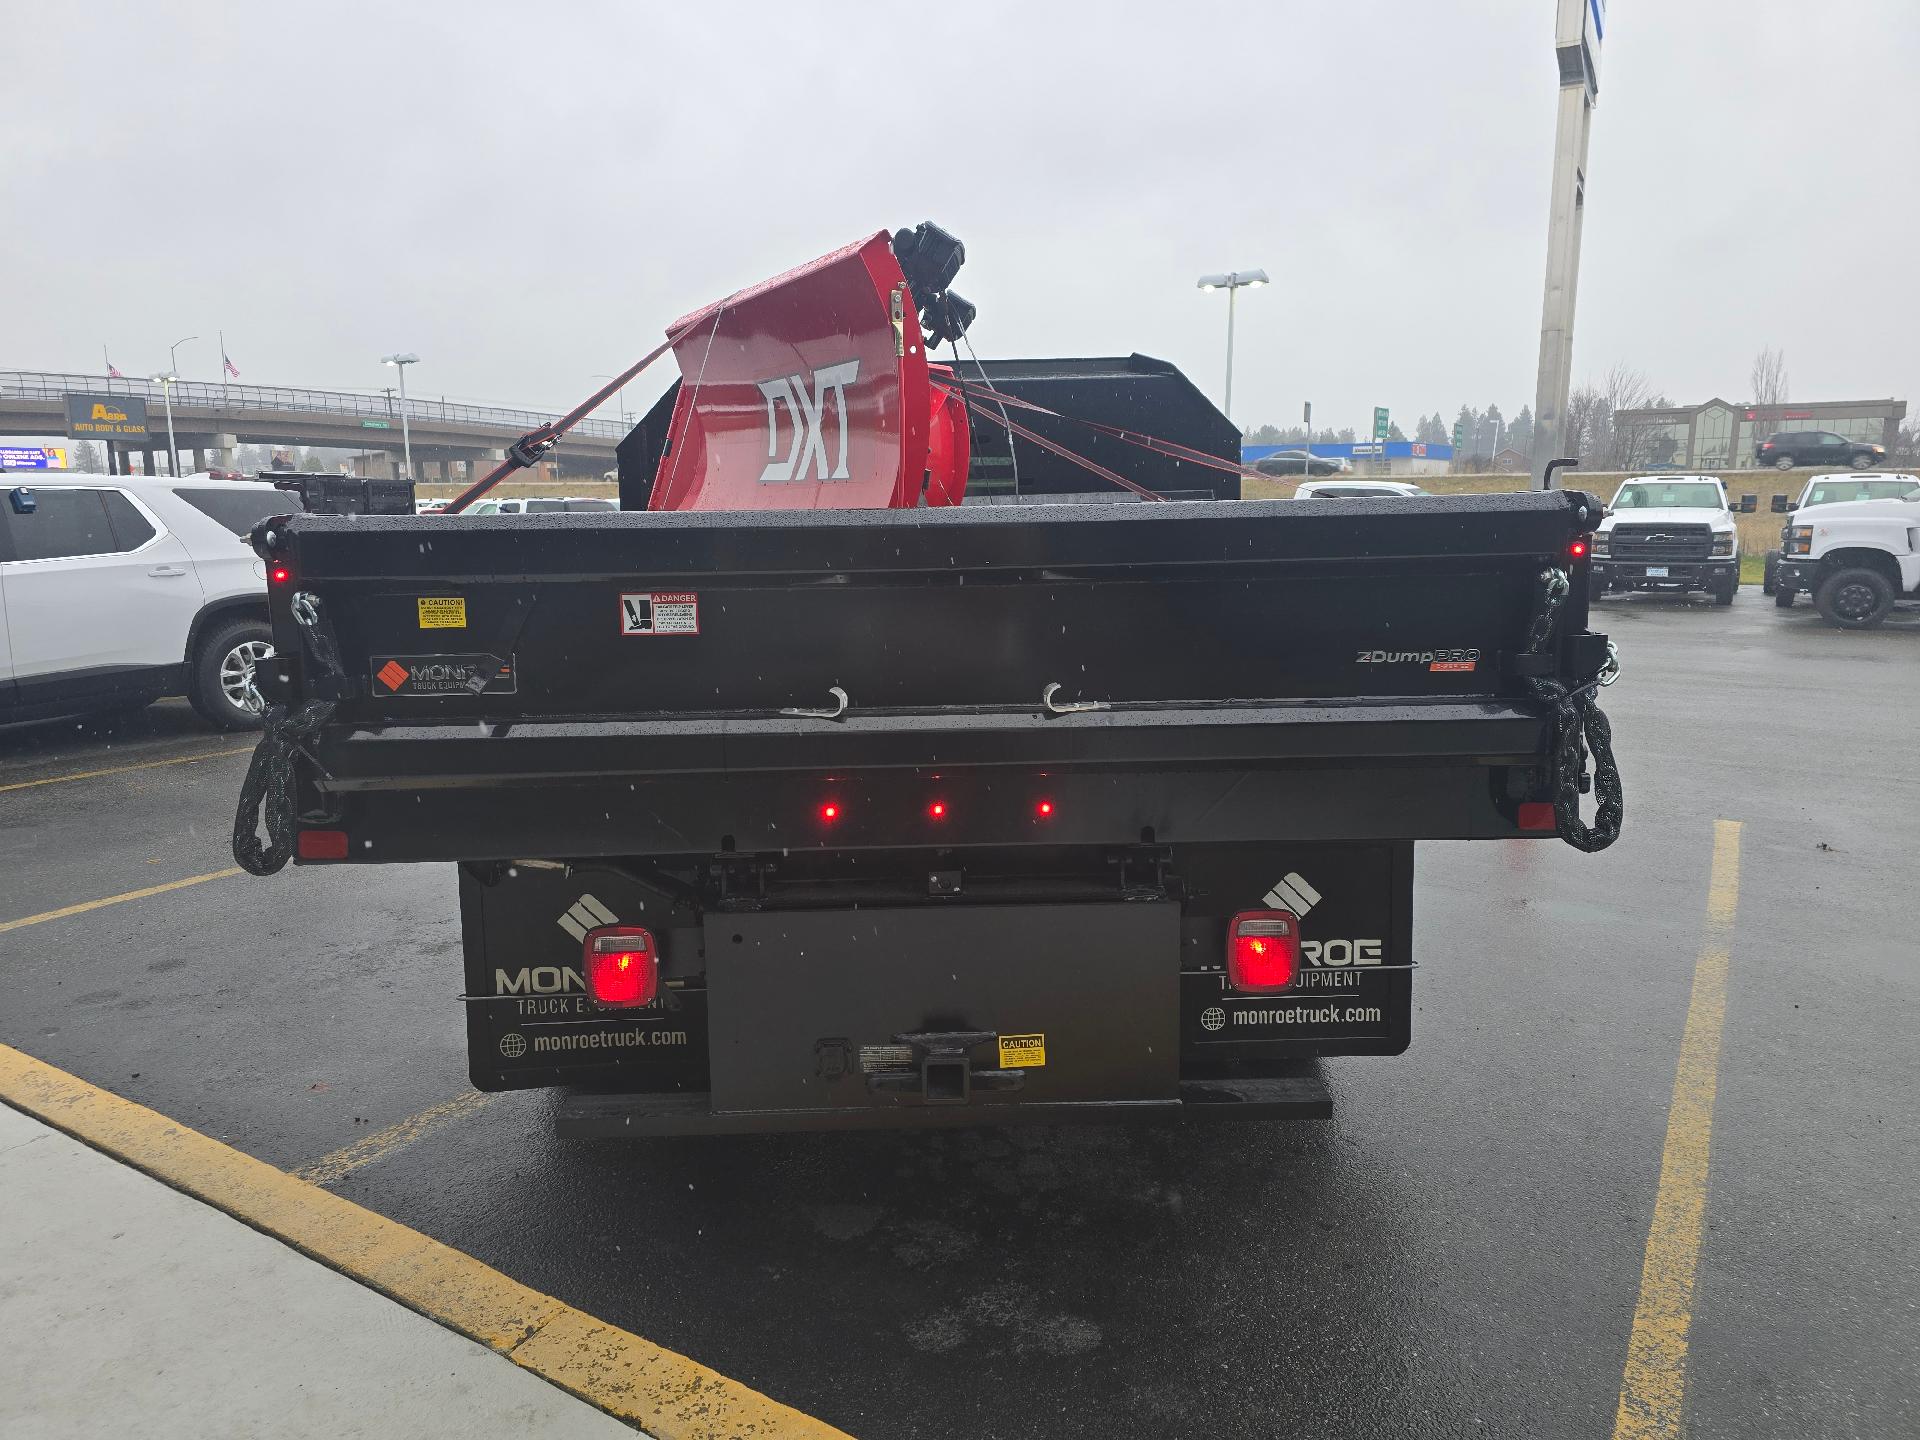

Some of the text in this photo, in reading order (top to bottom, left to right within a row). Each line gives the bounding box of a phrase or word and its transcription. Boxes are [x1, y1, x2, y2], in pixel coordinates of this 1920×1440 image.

[75, 423, 146, 433] AUTO BODY & GLASS
[757, 360, 860, 481] DXT
[662, 594, 697, 602] DANGER
[412, 681, 437, 690] TRUCK
[1301, 939, 1381, 965] ROE
[1295, 971, 1363, 989] UIPMENT
[516, 998, 570, 1015] TRUCK
[1233, 1004, 1381, 1026] monroetruck.com
[534, 1028, 688, 1052] monroetruck.com
[1002, 1038, 1042, 1049] CAUTION
